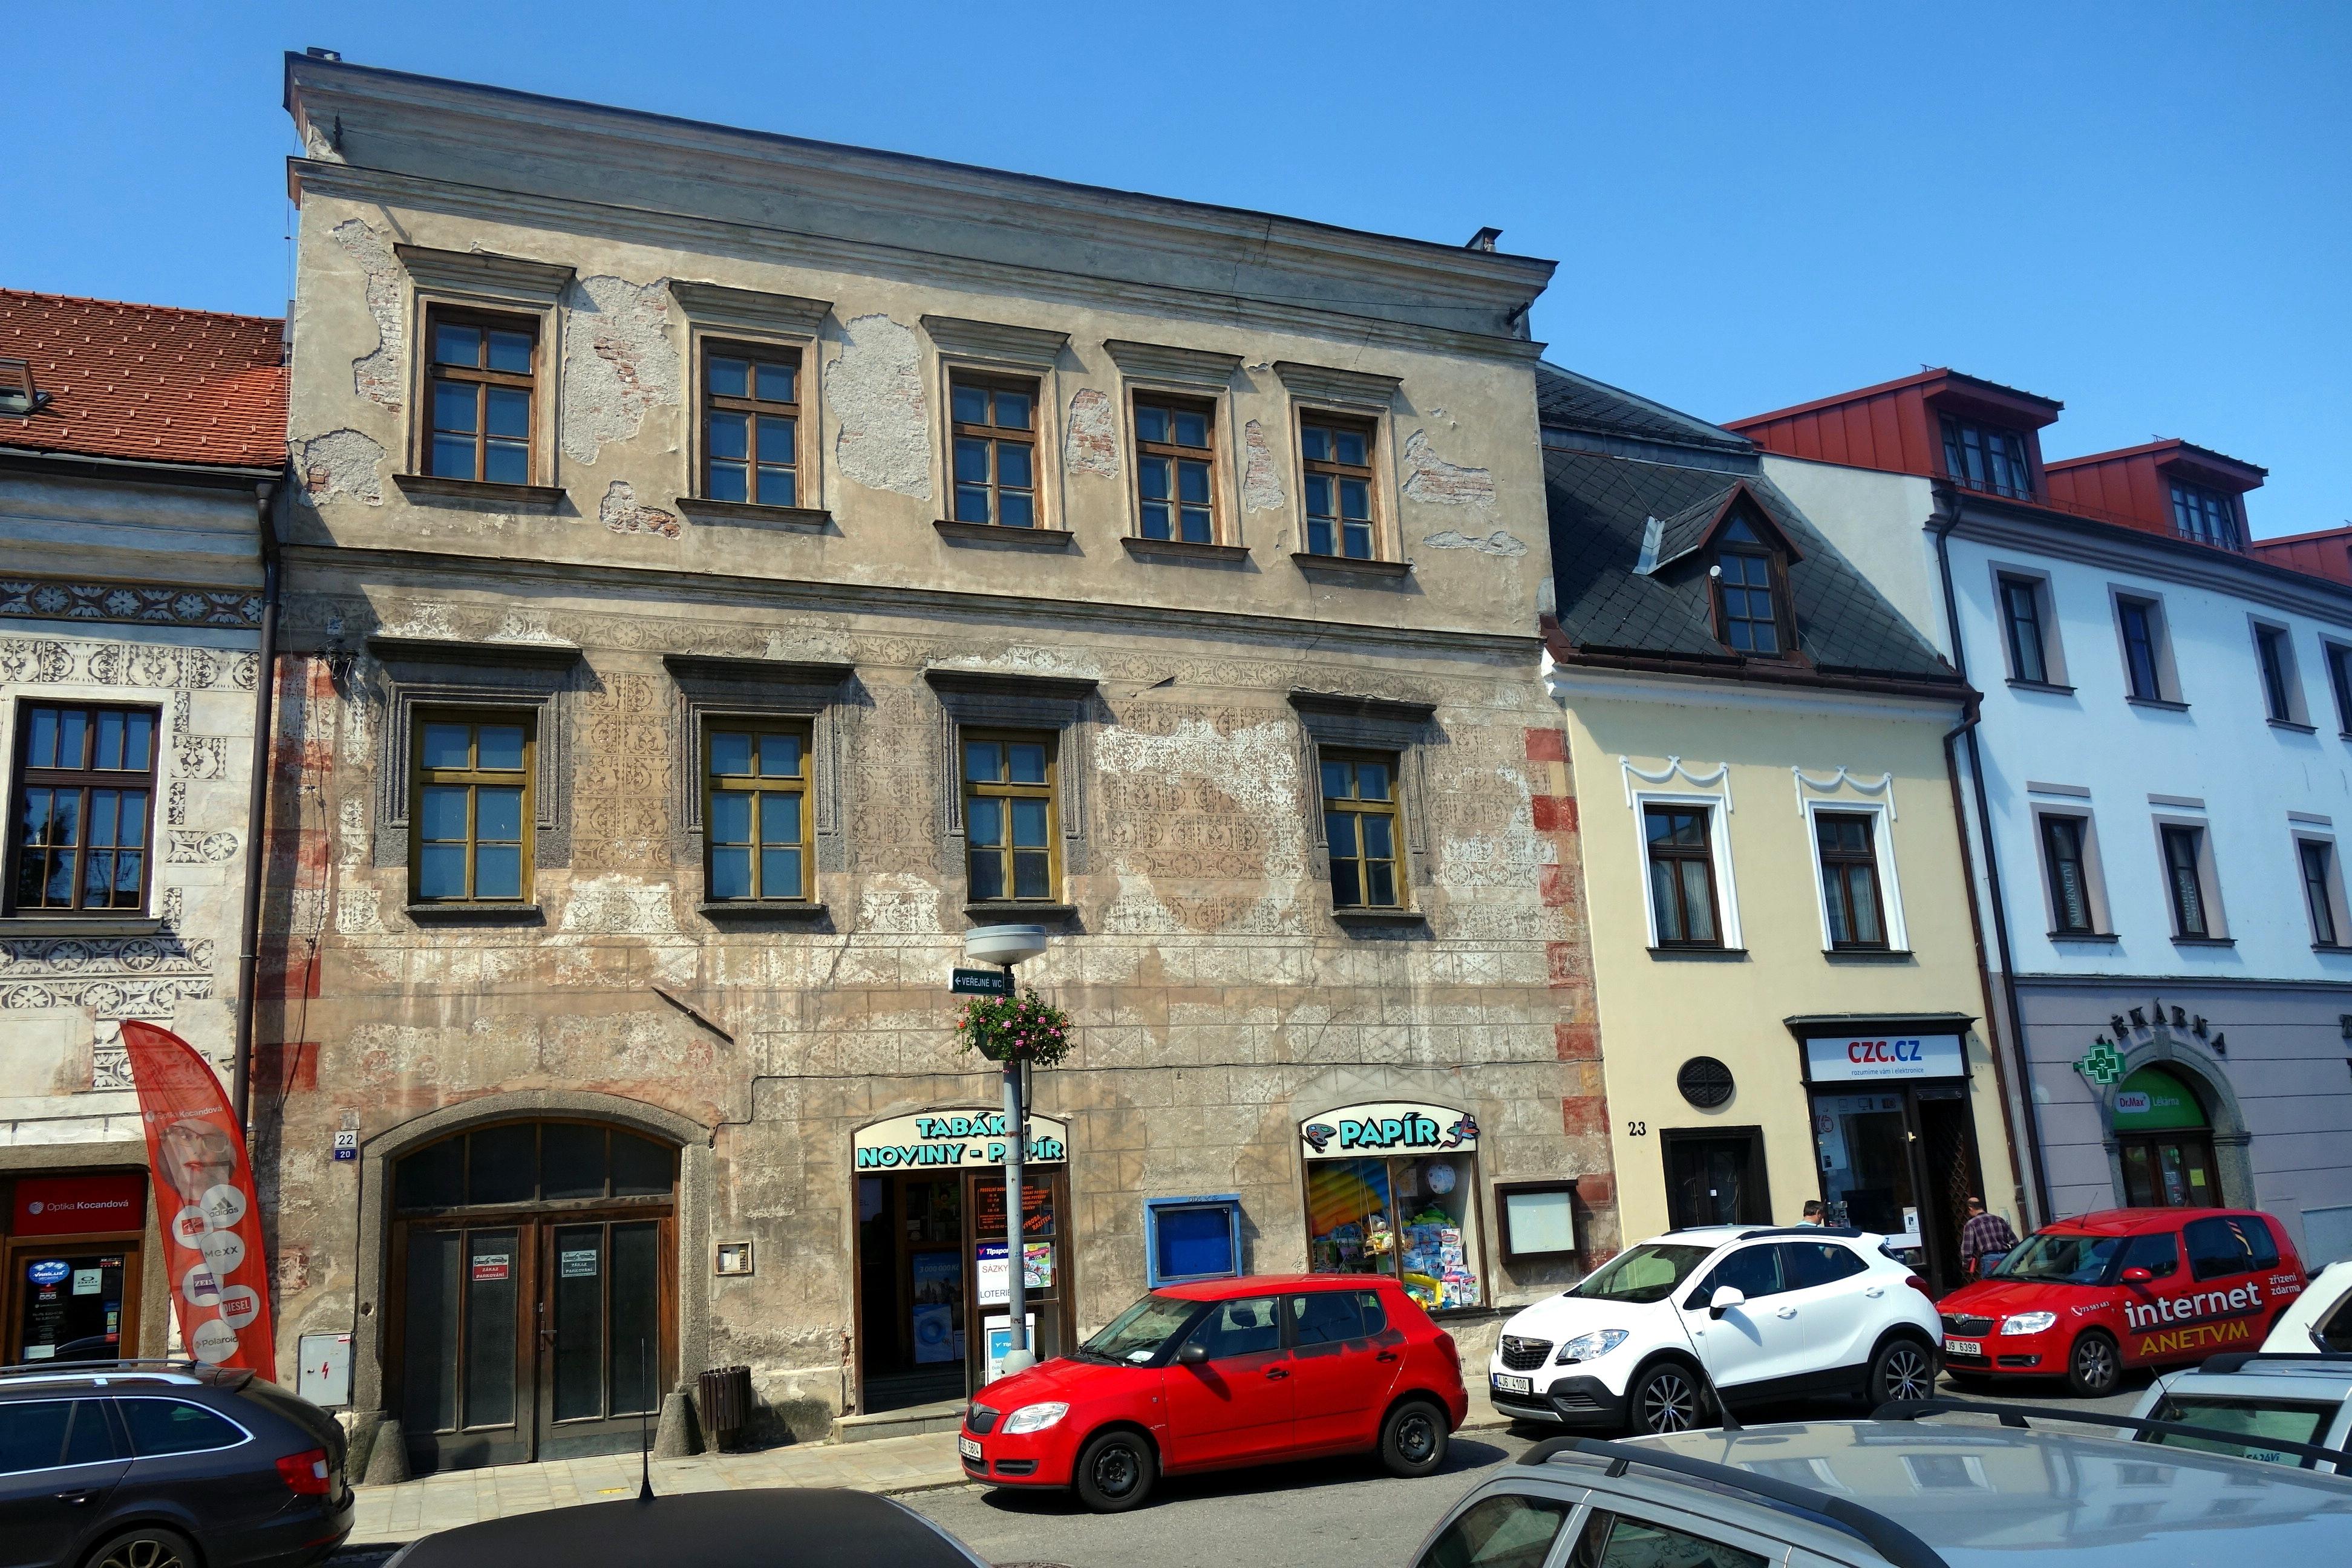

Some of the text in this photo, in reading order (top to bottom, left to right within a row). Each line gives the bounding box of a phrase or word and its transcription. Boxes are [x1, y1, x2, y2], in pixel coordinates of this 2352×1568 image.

[962, 976, 1002, 988] VEŘEJNÉ WC
[1847, 1040, 1922, 1063] CZC.CZ
[179, 1106, 223, 1118] Kocandová
[916, 1112, 1005, 1138] TABÁK
[1339, 1112, 1441, 1149] PAPÍR
[1628, 1121, 1647, 1136] 23
[339, 1134, 353, 1145] 22
[858, 1143, 966, 1168] NOVINY
[47, 1199, 129, 1212] Optika Kocandová
[209, 1206, 239, 1217] adidas
[986, 1248, 1009, 1256] Tipspor
[982, 1264, 1008, 1273] SÁZKY
[2270, 1283, 2301, 1296] zdarma
[224, 1301, 250, 1313] DIESEL
[2124, 1281, 2262, 1328] internet
[1959, 1342, 1977, 1353] 6399
[1498, 1376, 1526, 1390] 4J6 4100
